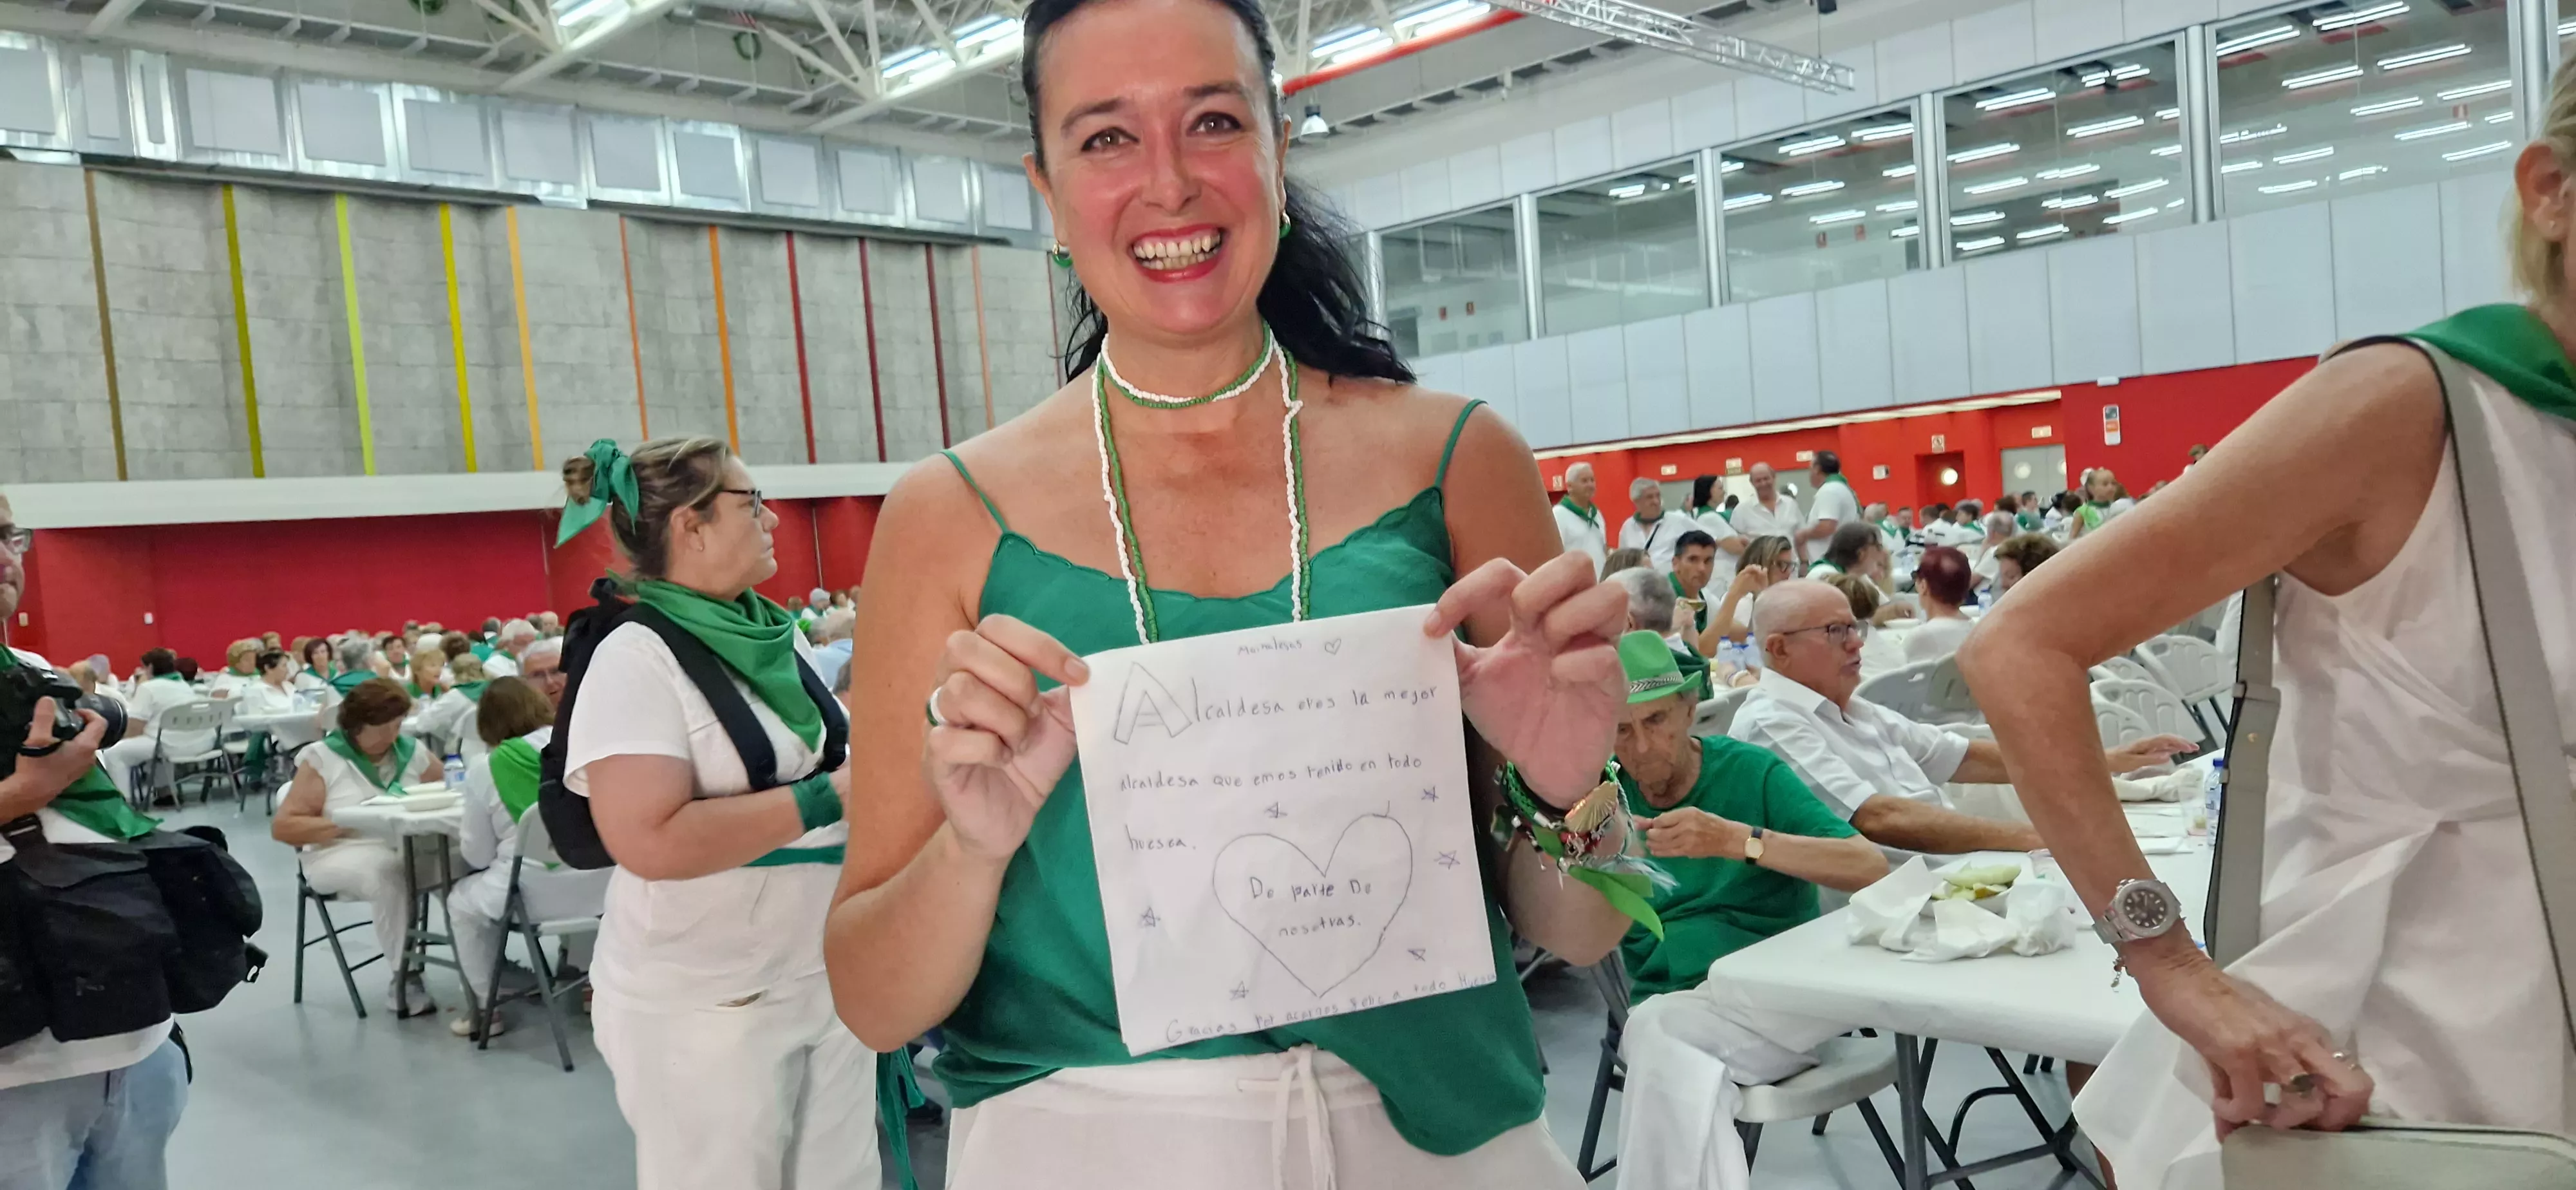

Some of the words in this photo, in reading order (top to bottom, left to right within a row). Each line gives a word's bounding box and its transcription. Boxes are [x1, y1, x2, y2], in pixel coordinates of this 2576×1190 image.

[1112, 661, 1285, 745] Alcaldesa
[1352, 689, 1370, 706] la
[1384, 686, 1437, 706] mejor
[1253, 771, 1297, 786] emos
[1360, 760, 1377, 772] en
[1388, 752, 1422, 770] todo
[1291, 883, 1335, 903] parte
